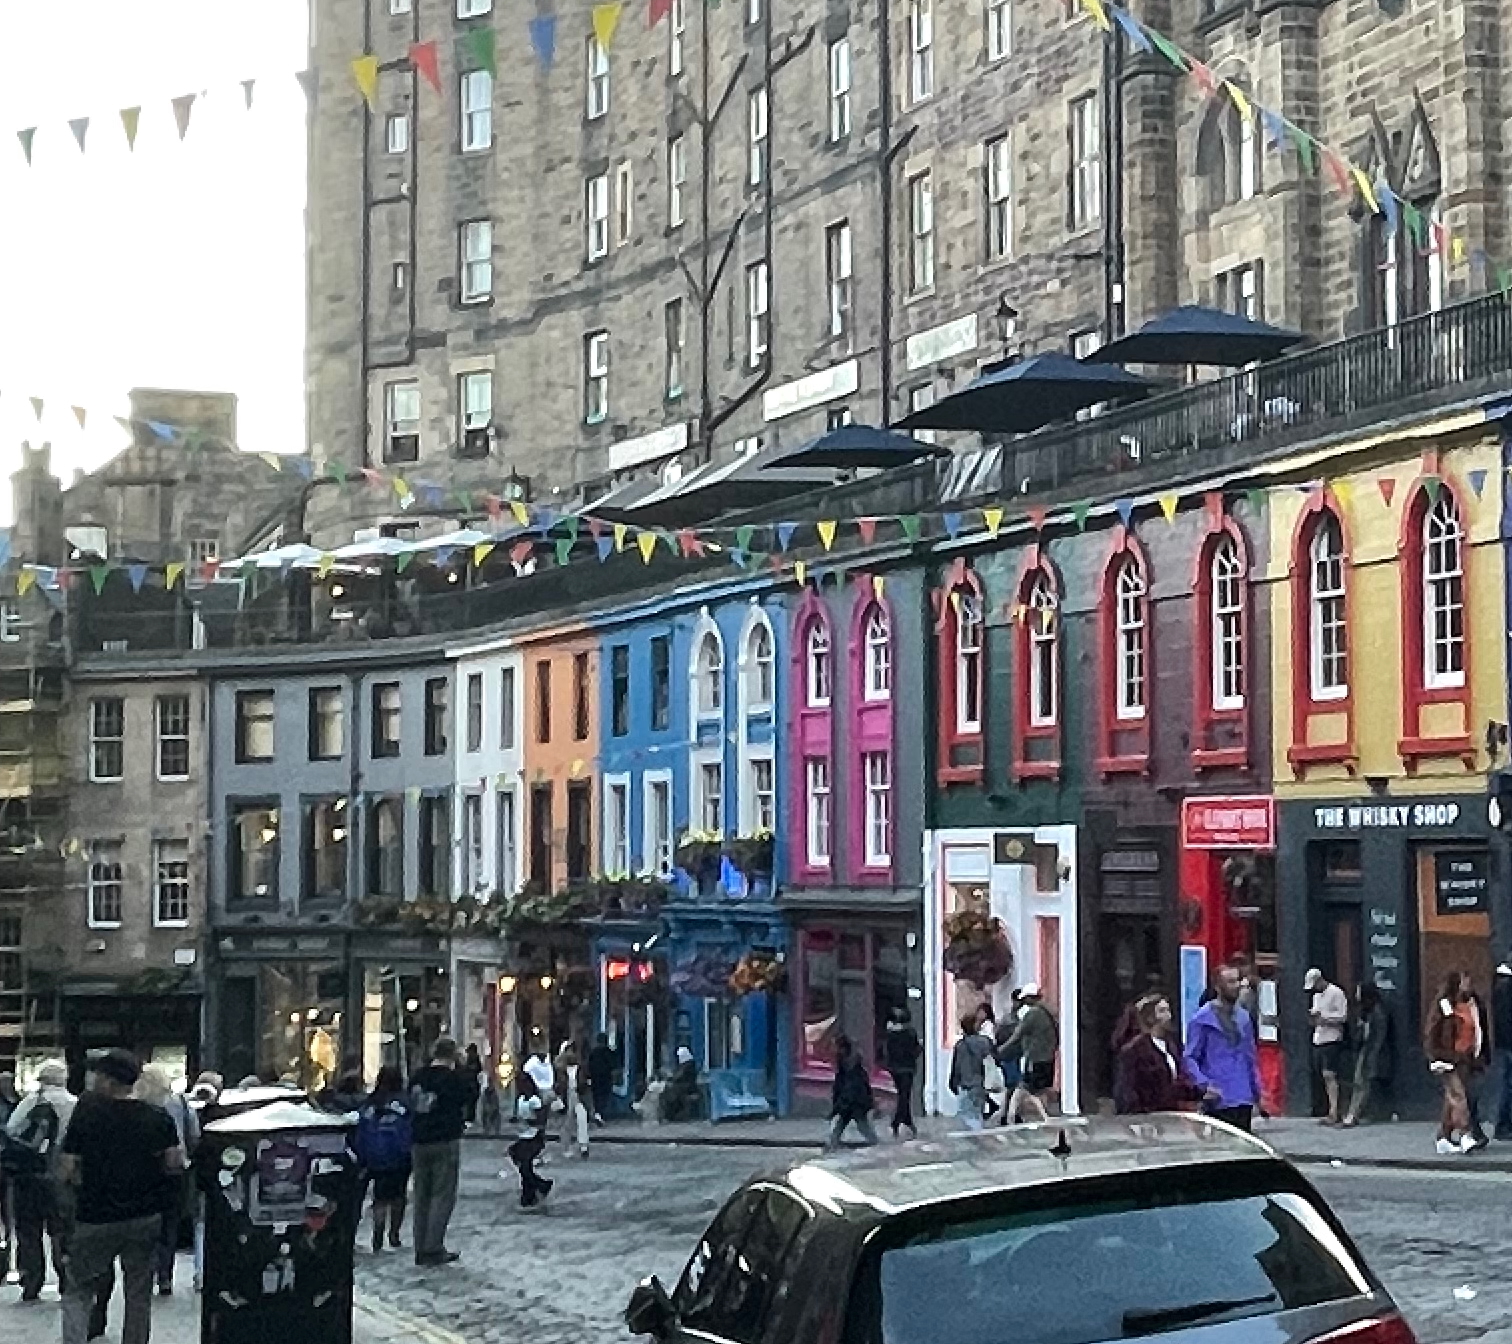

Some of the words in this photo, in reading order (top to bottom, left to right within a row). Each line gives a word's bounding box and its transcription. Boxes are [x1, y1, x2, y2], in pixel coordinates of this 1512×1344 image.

[1314, 806, 1344, 828] THE
[1348, 806, 1410, 827] WHISKY
[1413, 803, 1461, 826] SHOP
